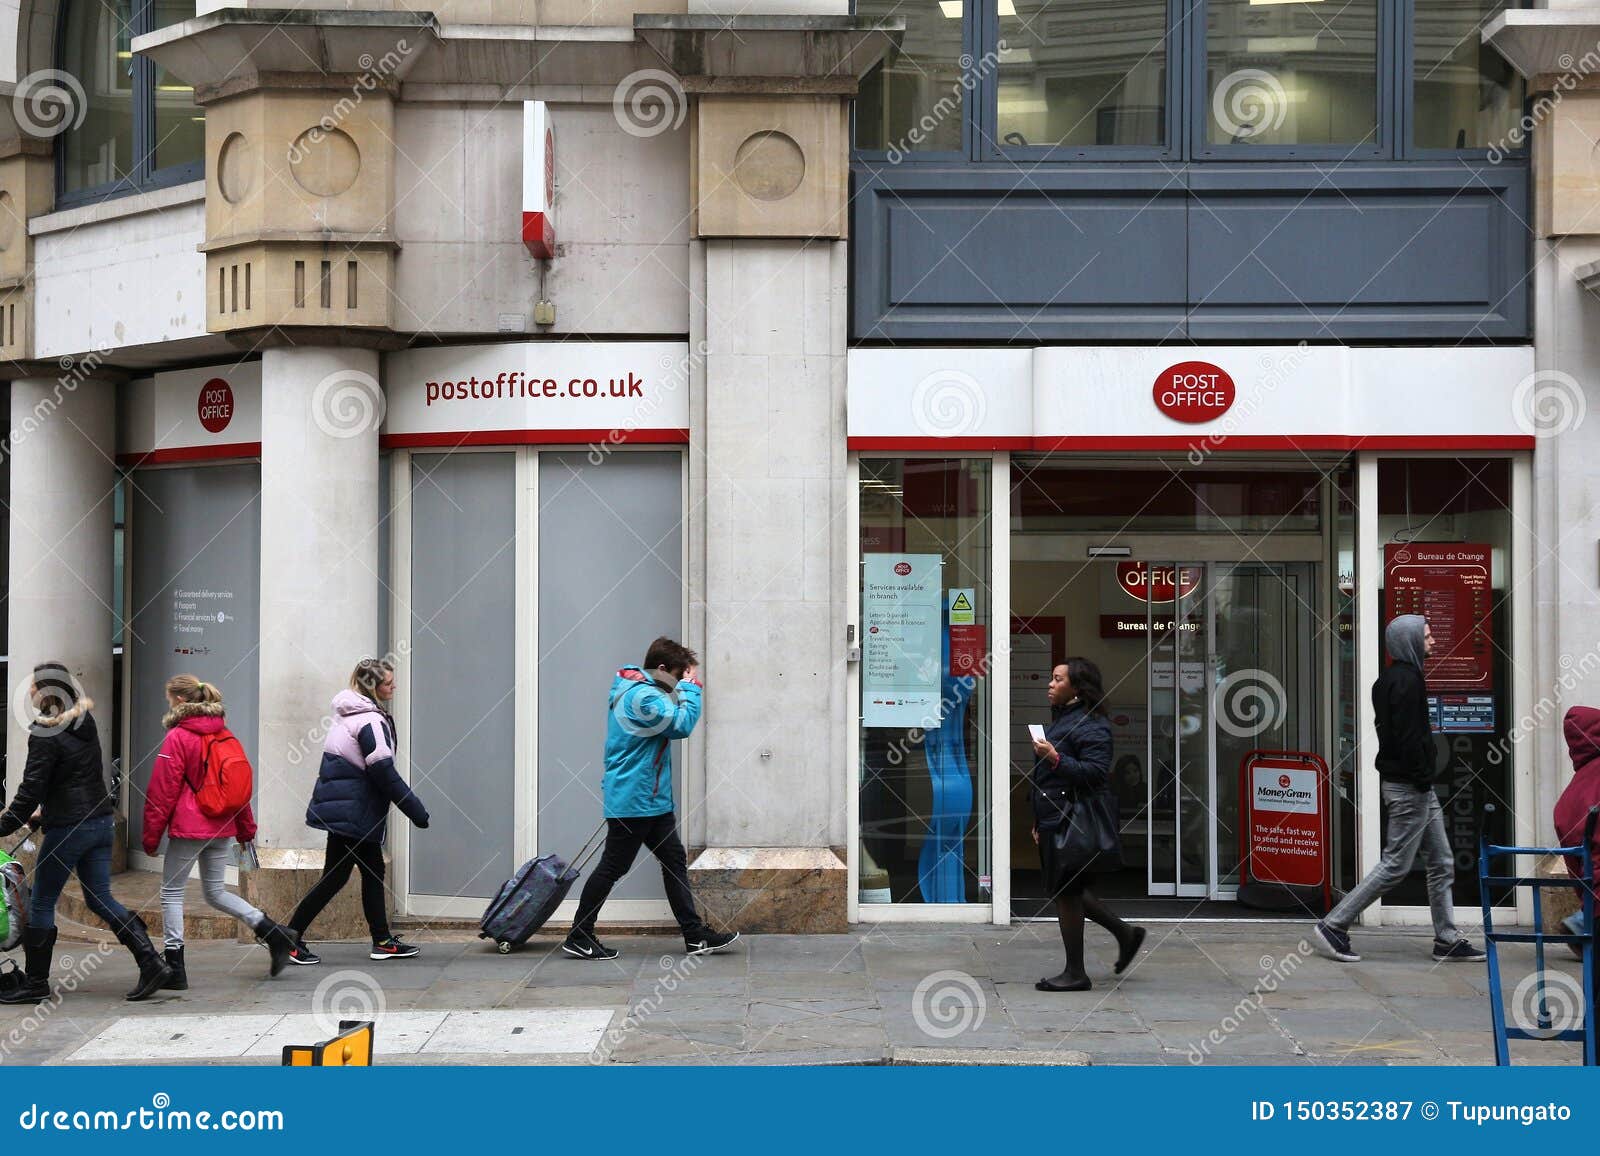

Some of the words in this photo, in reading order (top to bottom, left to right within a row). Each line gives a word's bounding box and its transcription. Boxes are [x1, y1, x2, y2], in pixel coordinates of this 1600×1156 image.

[1172, 374, 1220, 389] POST
[425, 372, 643, 406] postoffice.co.uk
[205, 389, 227, 404] POST
[1161, 391, 1226, 407] OFFICE
[201, 404, 230, 419] OFFICE
[1417, 552, 1444, 560] Bureau
[1446, 552, 1456, 560] de
[1457, 552, 1485, 563] Change
[1153, 621, 1165, 630] de
[1167, 621, 1201, 632] Cang
[1257, 787, 1312, 799] MoneyGram
[1256, 824, 1269, 833] The
[1269, 825, 1286, 835] safe,
[1286, 827, 1300, 835] fast
[1301, 829, 1316, 838] way
[1280, 837, 1293, 845] and
[1294, 839, 1319, 847] receive
[1256, 845, 1280, 855] money
[1280, 846, 1318, 857] worldwide
